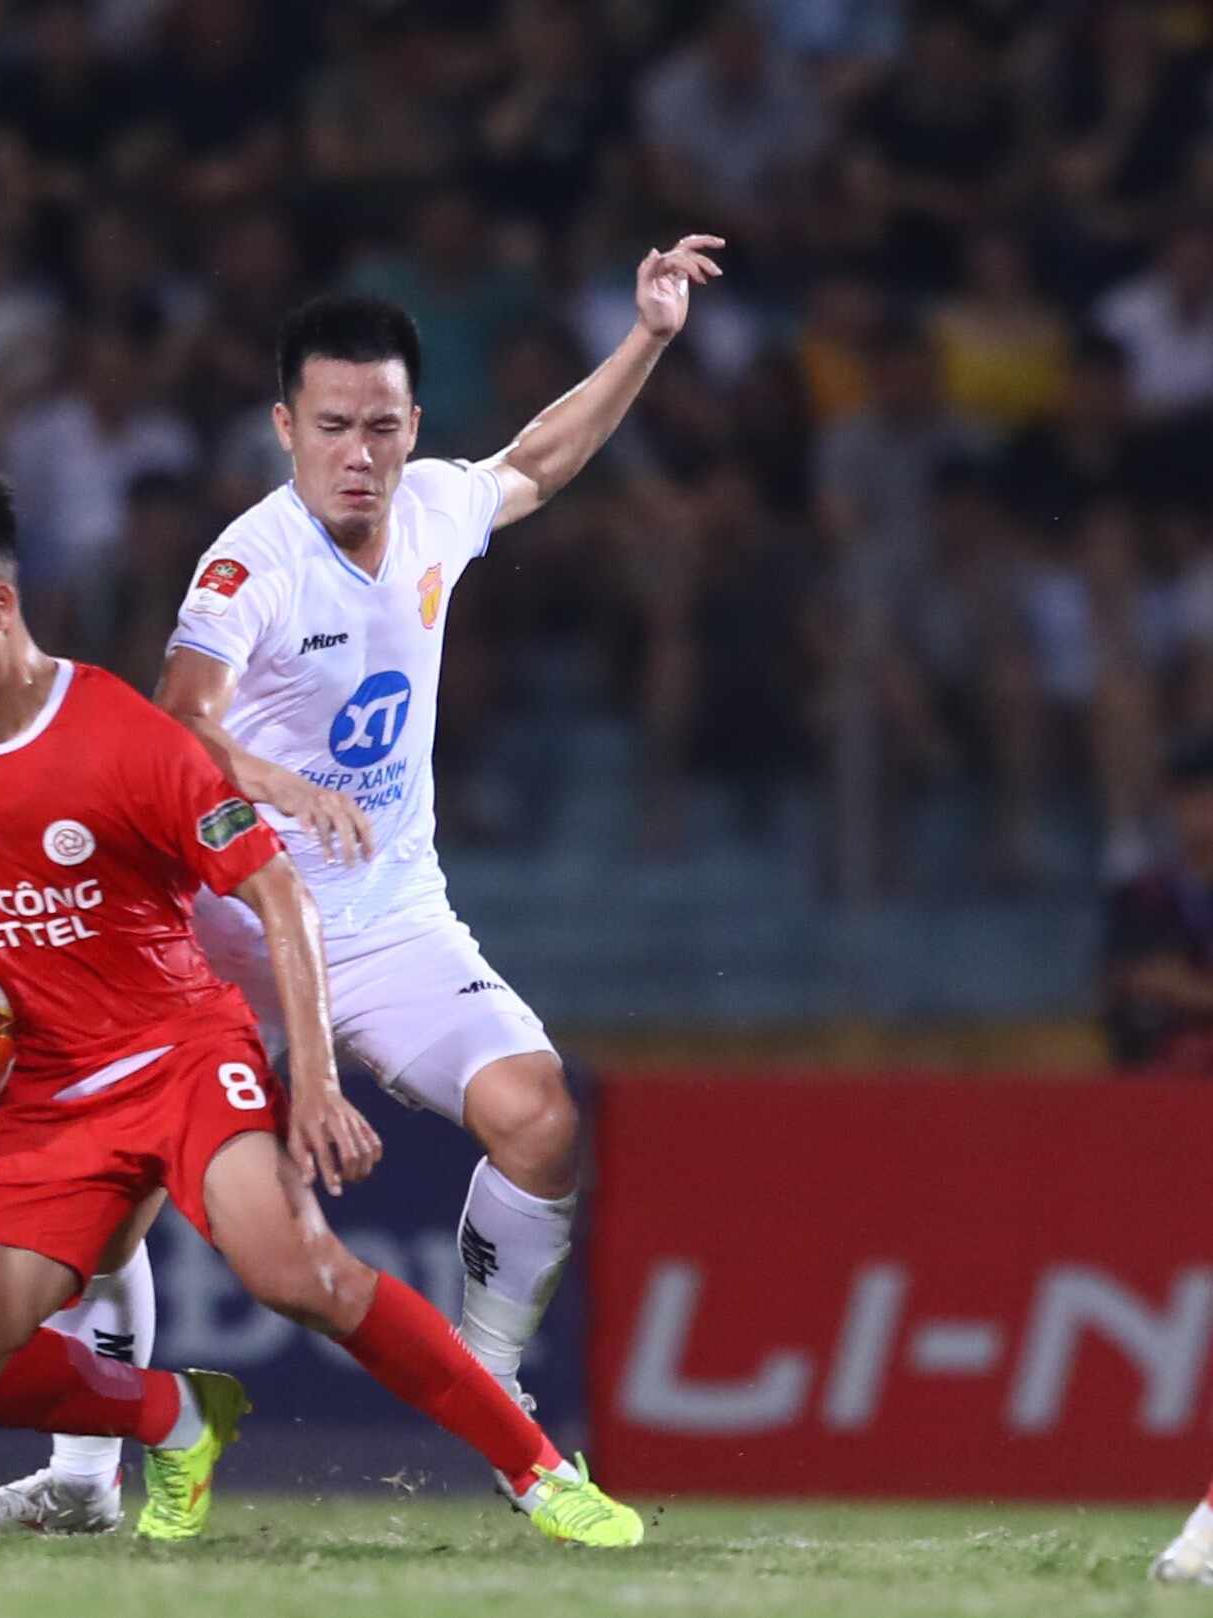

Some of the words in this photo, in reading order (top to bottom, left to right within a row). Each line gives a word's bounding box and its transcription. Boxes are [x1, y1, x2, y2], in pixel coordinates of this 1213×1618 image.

[299, 632, 349, 655] Mitre
[358, 758, 406, 791] XANH
[218, 1062, 267, 1111] 8
